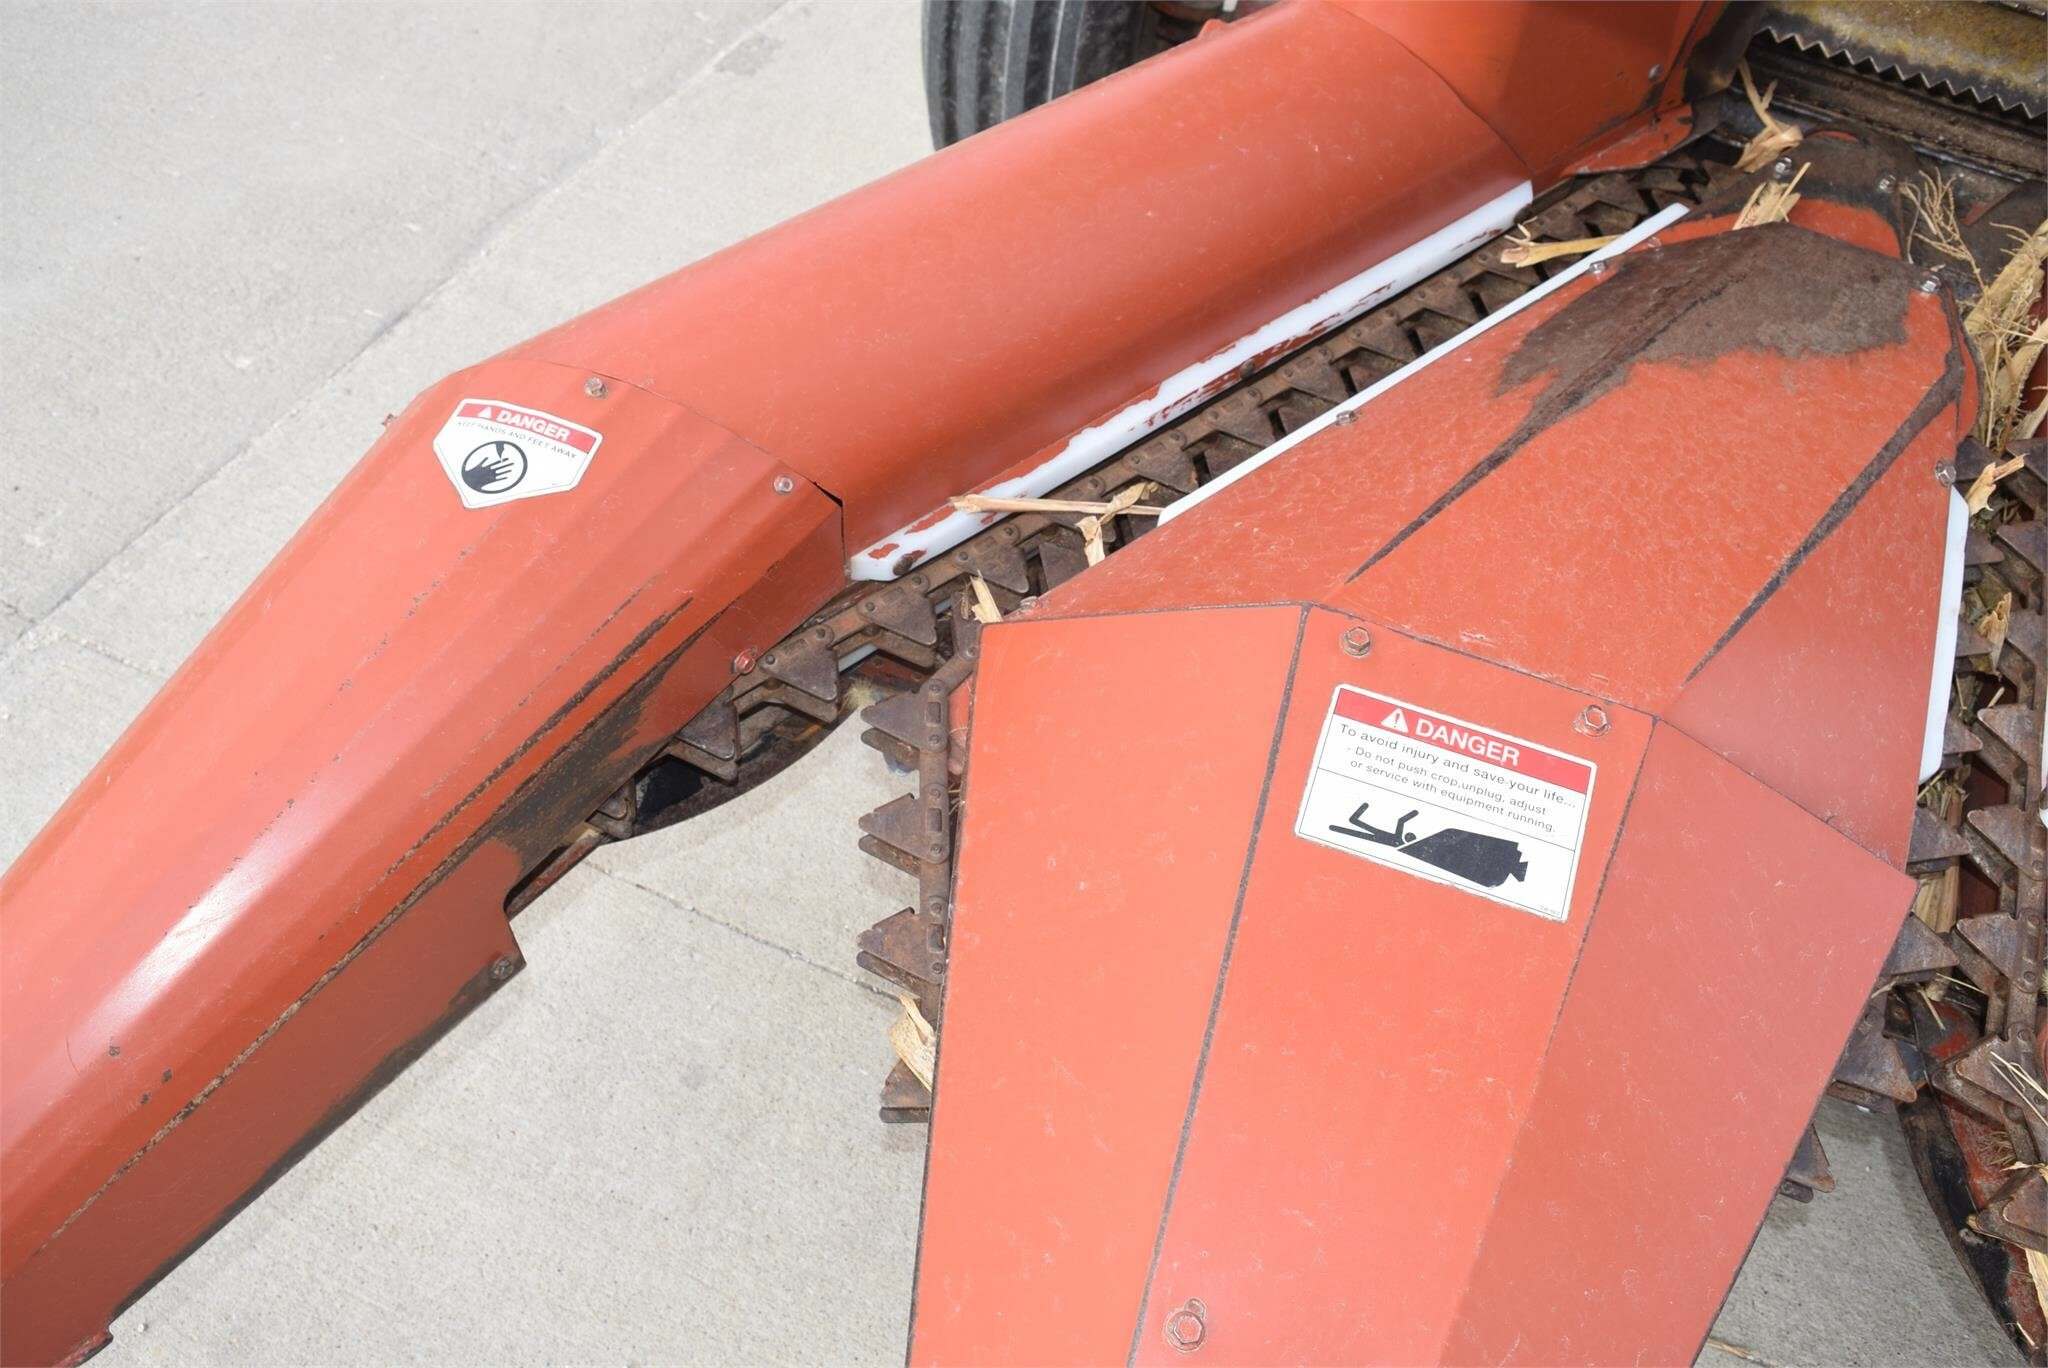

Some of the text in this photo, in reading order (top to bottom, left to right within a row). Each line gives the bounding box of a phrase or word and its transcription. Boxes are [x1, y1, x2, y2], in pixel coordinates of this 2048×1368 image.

[477, 423, 506, 435] HANDS
[508, 431, 527, 440] AND
[528, 436, 551, 448] FEET
[551, 445, 577, 459] AWAY
[496, 410, 571, 442] DANGER
[1340, 724, 1357, 737] To
[1360, 730, 1398, 750] avoid
[1402, 741, 1439, 763] injury
[1443, 755, 1469, 773] and
[1508, 780, 1541, 796] your
[1415, 718, 1520, 767] DANGER
[1350, 759, 1557, 834] or service with equipment running.
[1355, 746, 1372, 759] Do
[1375, 753, 1395, 767] not
[1398, 758, 1428, 776] push
[1510, 798, 1547, 816] adjust
